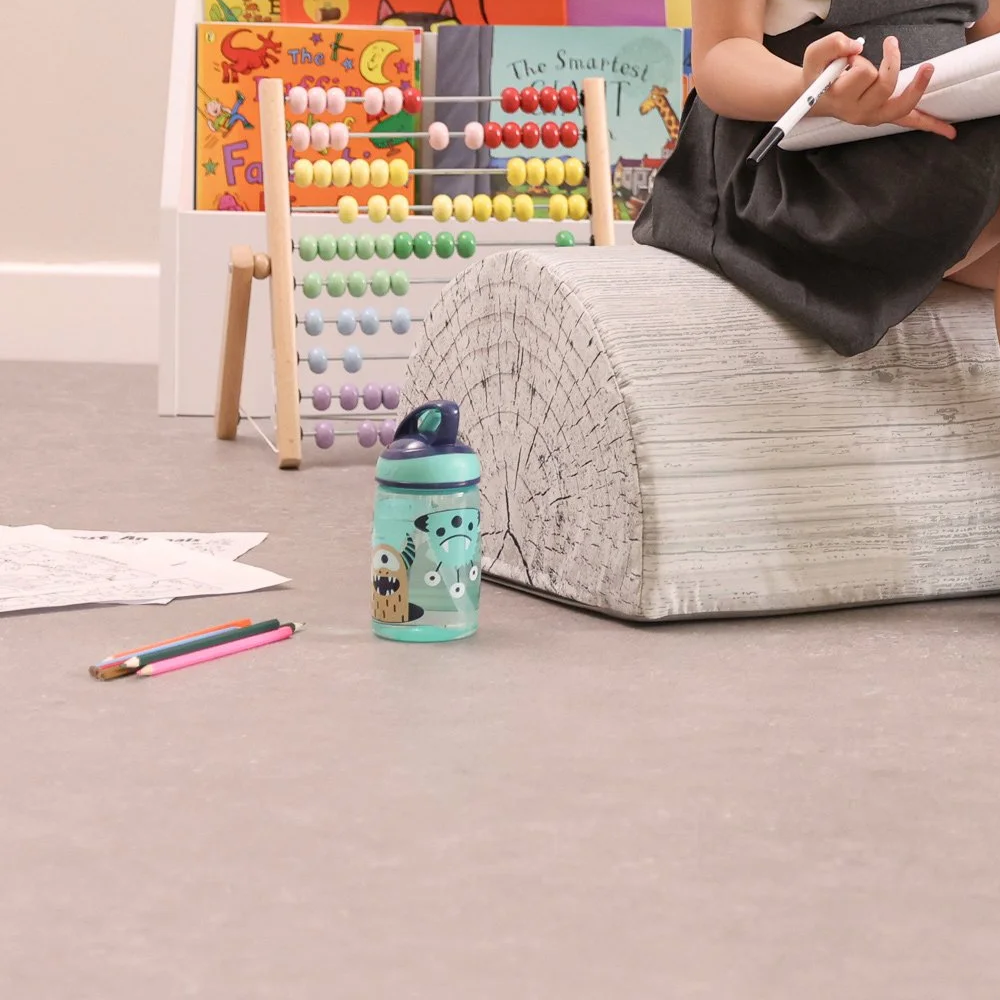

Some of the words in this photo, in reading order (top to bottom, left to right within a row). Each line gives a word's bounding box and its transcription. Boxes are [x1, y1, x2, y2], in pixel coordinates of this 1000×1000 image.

[288, 48, 325, 66] The
[506, 59, 547, 80] The
[554, 48, 649, 82] Smartest
